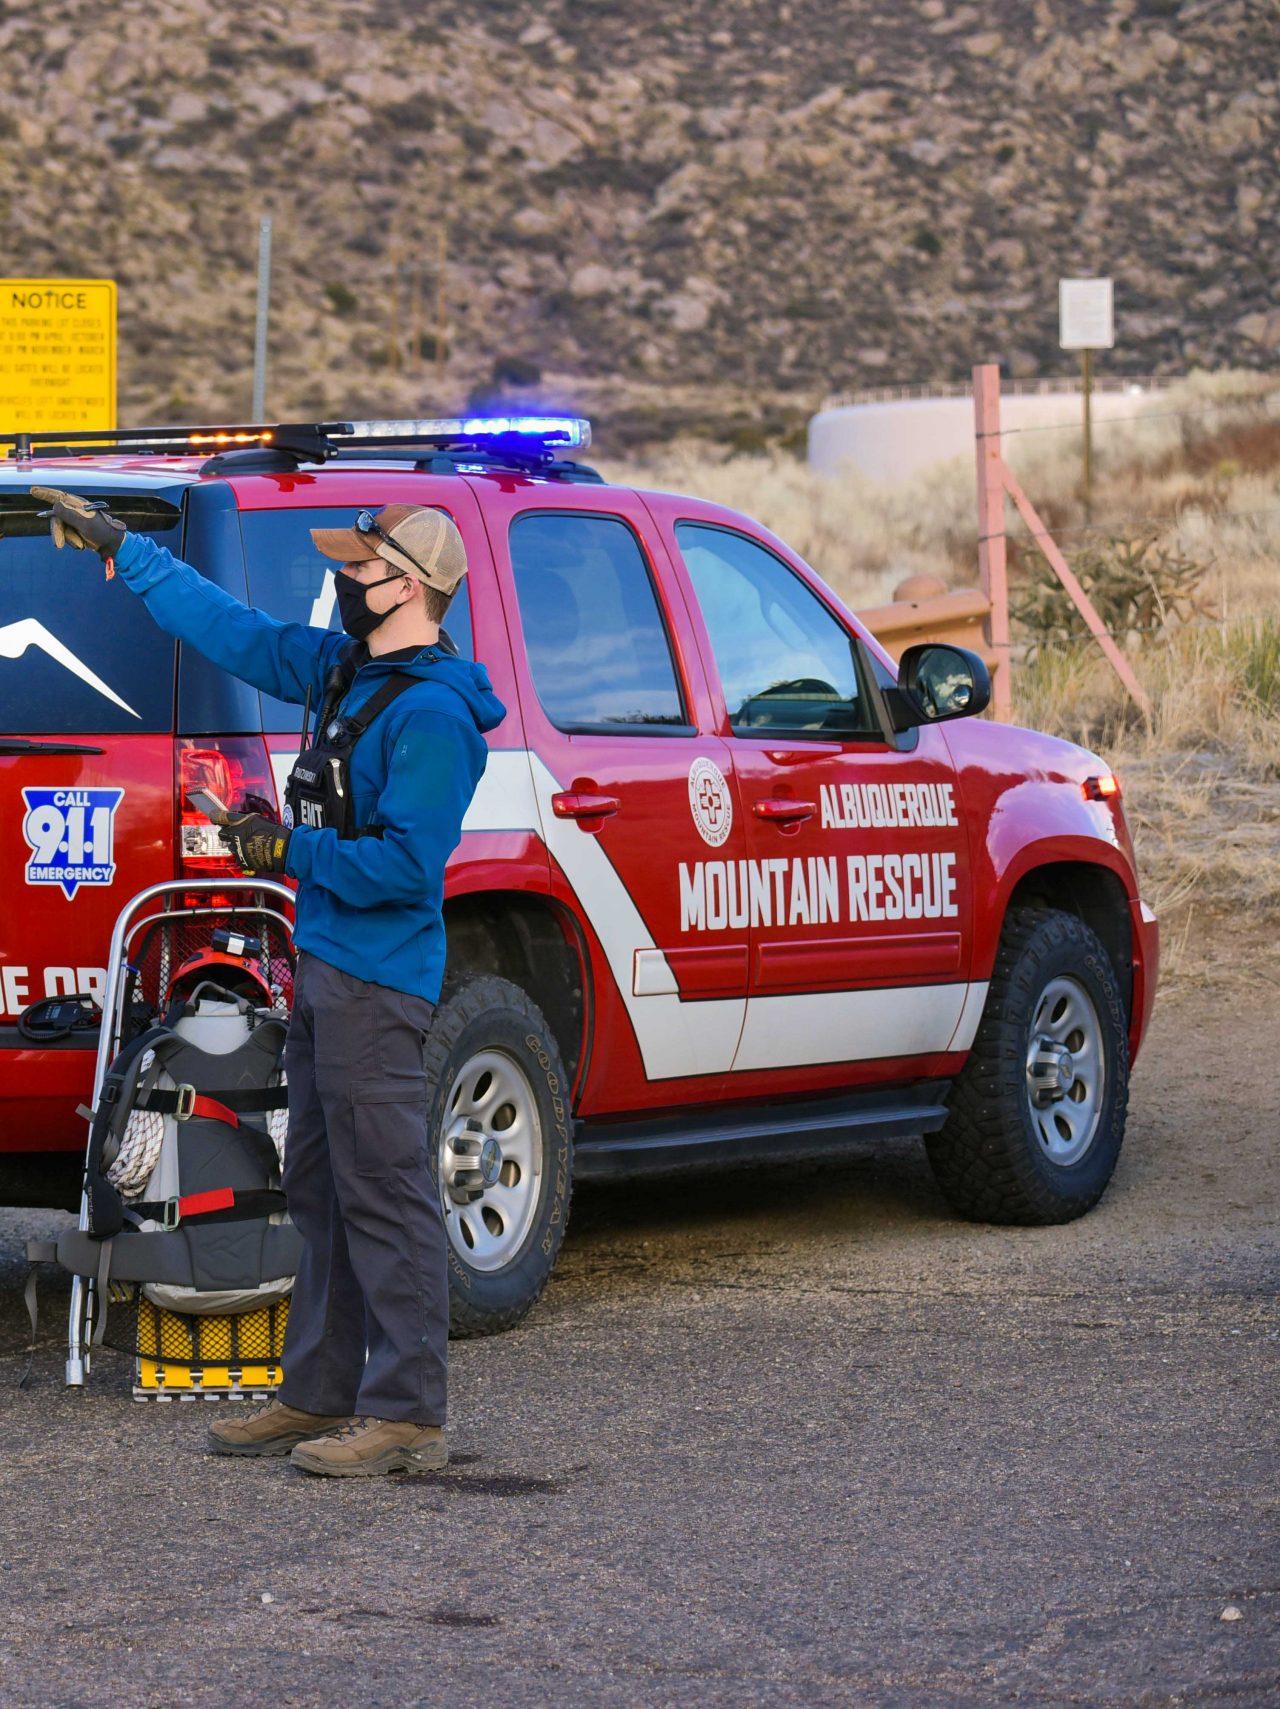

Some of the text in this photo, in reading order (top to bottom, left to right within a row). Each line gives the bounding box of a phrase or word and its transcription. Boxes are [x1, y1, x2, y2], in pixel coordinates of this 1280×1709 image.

[12, 292, 87, 309] NOTICE
[53, 791, 91, 806] CALL
[820, 783, 958, 829] ALBUQUERQUE
[300, 799, 323, 829] EMT
[29, 866, 111, 881] EMERGENCY
[678, 852, 959, 931] MOUNTAIN RESCUE
[526, 1034, 570, 1256] GOODYEAR
